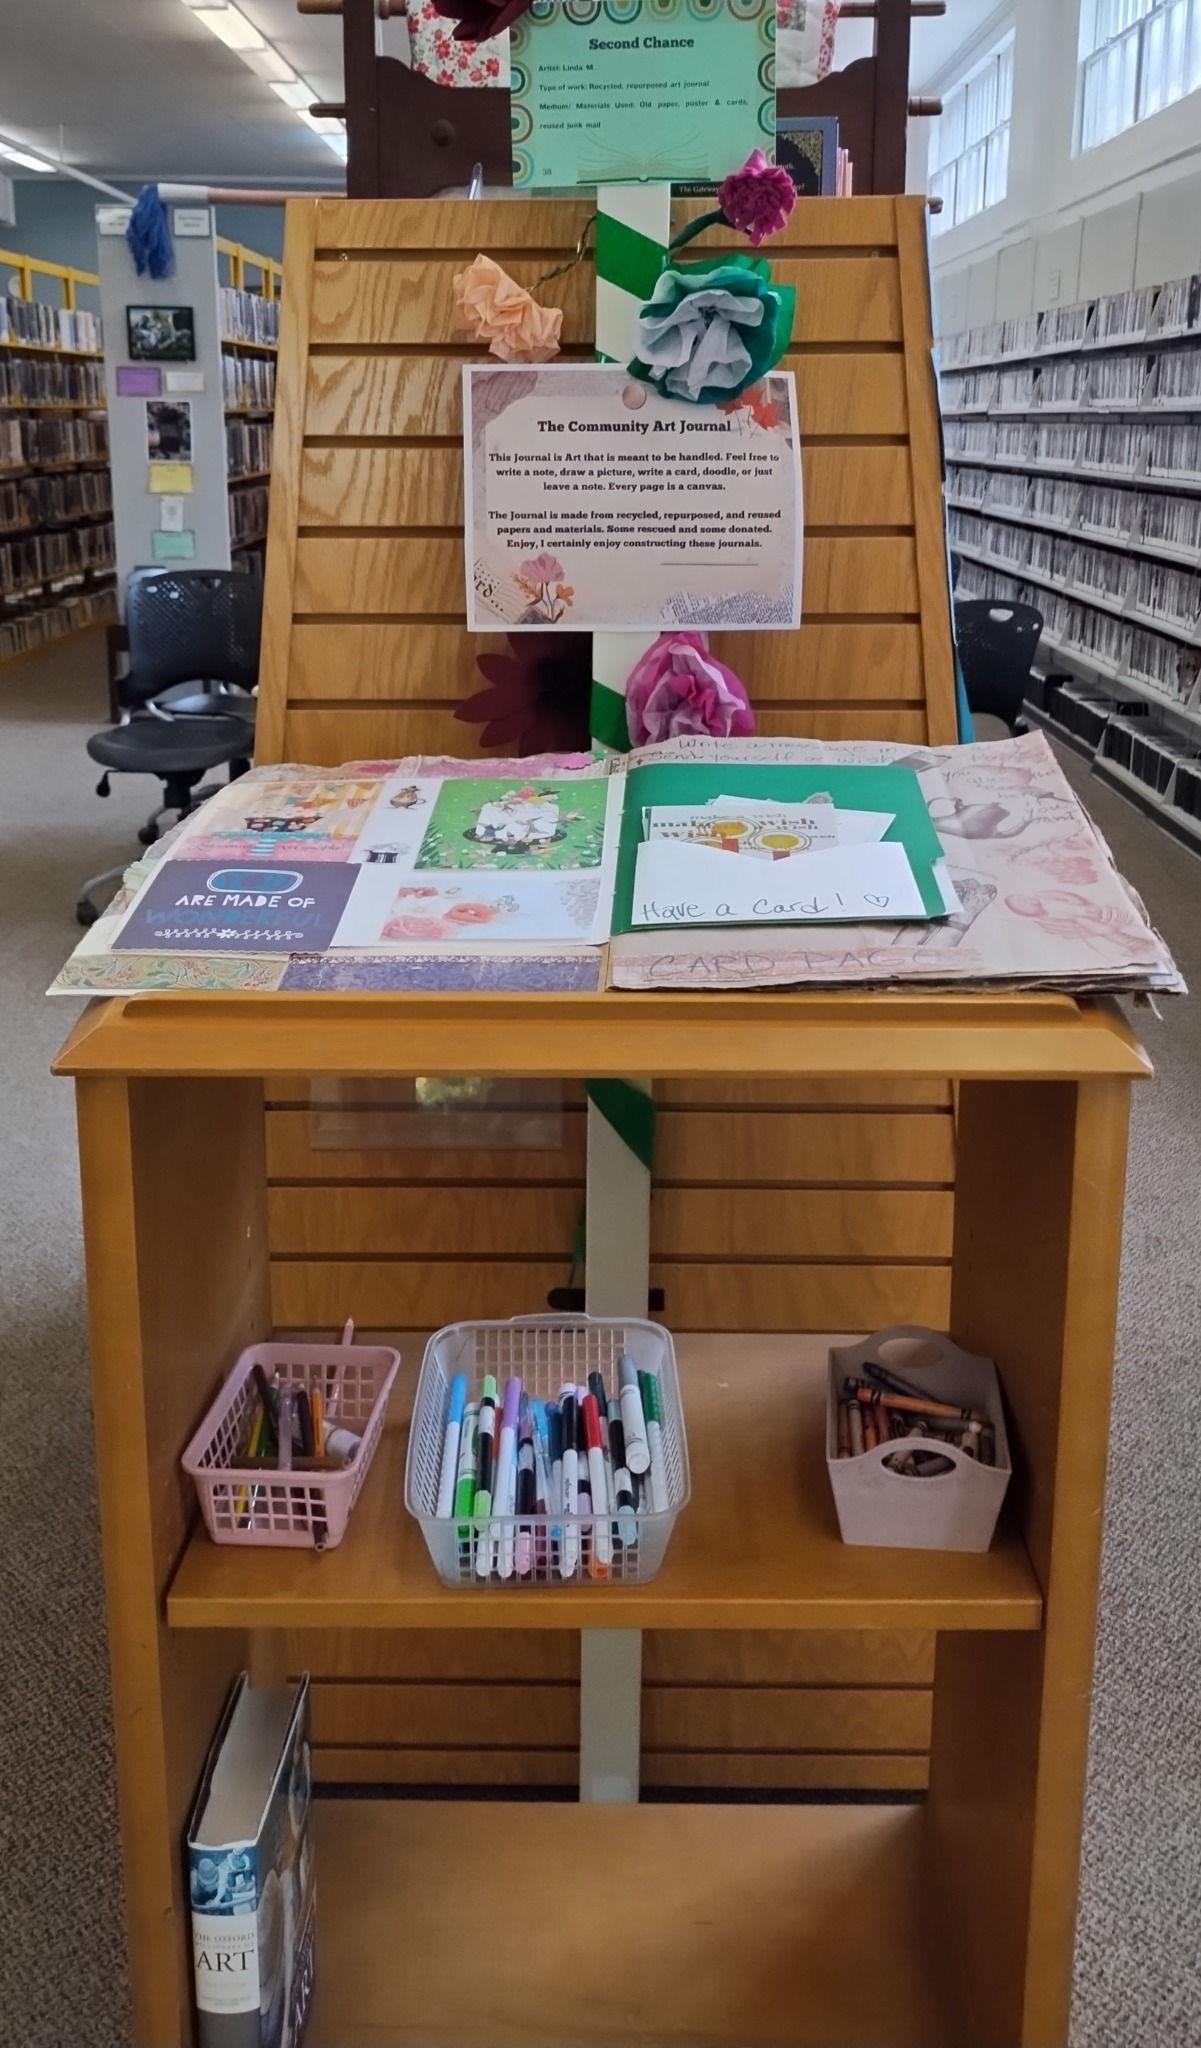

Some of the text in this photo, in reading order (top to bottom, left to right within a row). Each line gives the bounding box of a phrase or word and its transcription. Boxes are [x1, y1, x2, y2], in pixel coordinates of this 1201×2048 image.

[588, 35, 695, 51] Second Chance
[538, 63, 596, 72] Artist: Linda M.
[538, 80, 710, 93] Type of work: Recycled, repurposed art journal
[539, 98, 749, 111] Medium/ Materials Used: Old paper, poster & cards,
[539, 121, 601, 130] reused junk mail
[536, 419, 732, 436] The Community Art Journal
[488, 451, 780, 464] This Journal is Art that is meant to be handled. Feel free to
[495, 467, 522, 477] write
[523, 469, 531, 477] a
[532, 468, 558, 478] note,
[559, 467, 586, 477] draw
[587, 469, 595, 477] a
[596, 467, 636, 479] picture,
[637, 467, 664, 477] write
[674, 466, 701, 478] card,
[702, 466, 740, 478] doodle,
[741, 468, 752, 476] or
[754, 466, 773, 478] just
[543, 481, 726, 493] leave a note. Every page is a canvas.
[487, 509, 782, 522] The Journal is made from recycled, repurposed, and reused
[496, 527, 531, 536] papers
[532, 524, 553, 534] and
[554, 524, 605, 534] materials.
[606, 524, 635, 533] Some
[637, 524, 676, 534] rescued
[678, 524, 698, 534] and
[728, 524, 773, 534] donated.
[506, 538, 763, 550] Enjoy, I certainly enjoy constructing these journals.
[174, 893, 316, 908] ARE MADE OF
[144, 907, 328, 928] WONDERFUL
[640, 901, 706, 922] Have
[715, 903, 738, 917] a
[648, 954, 776, 977] CARD
[213, 1932, 255, 1942] OXFORD
[196, 1949, 255, 1973] ART
